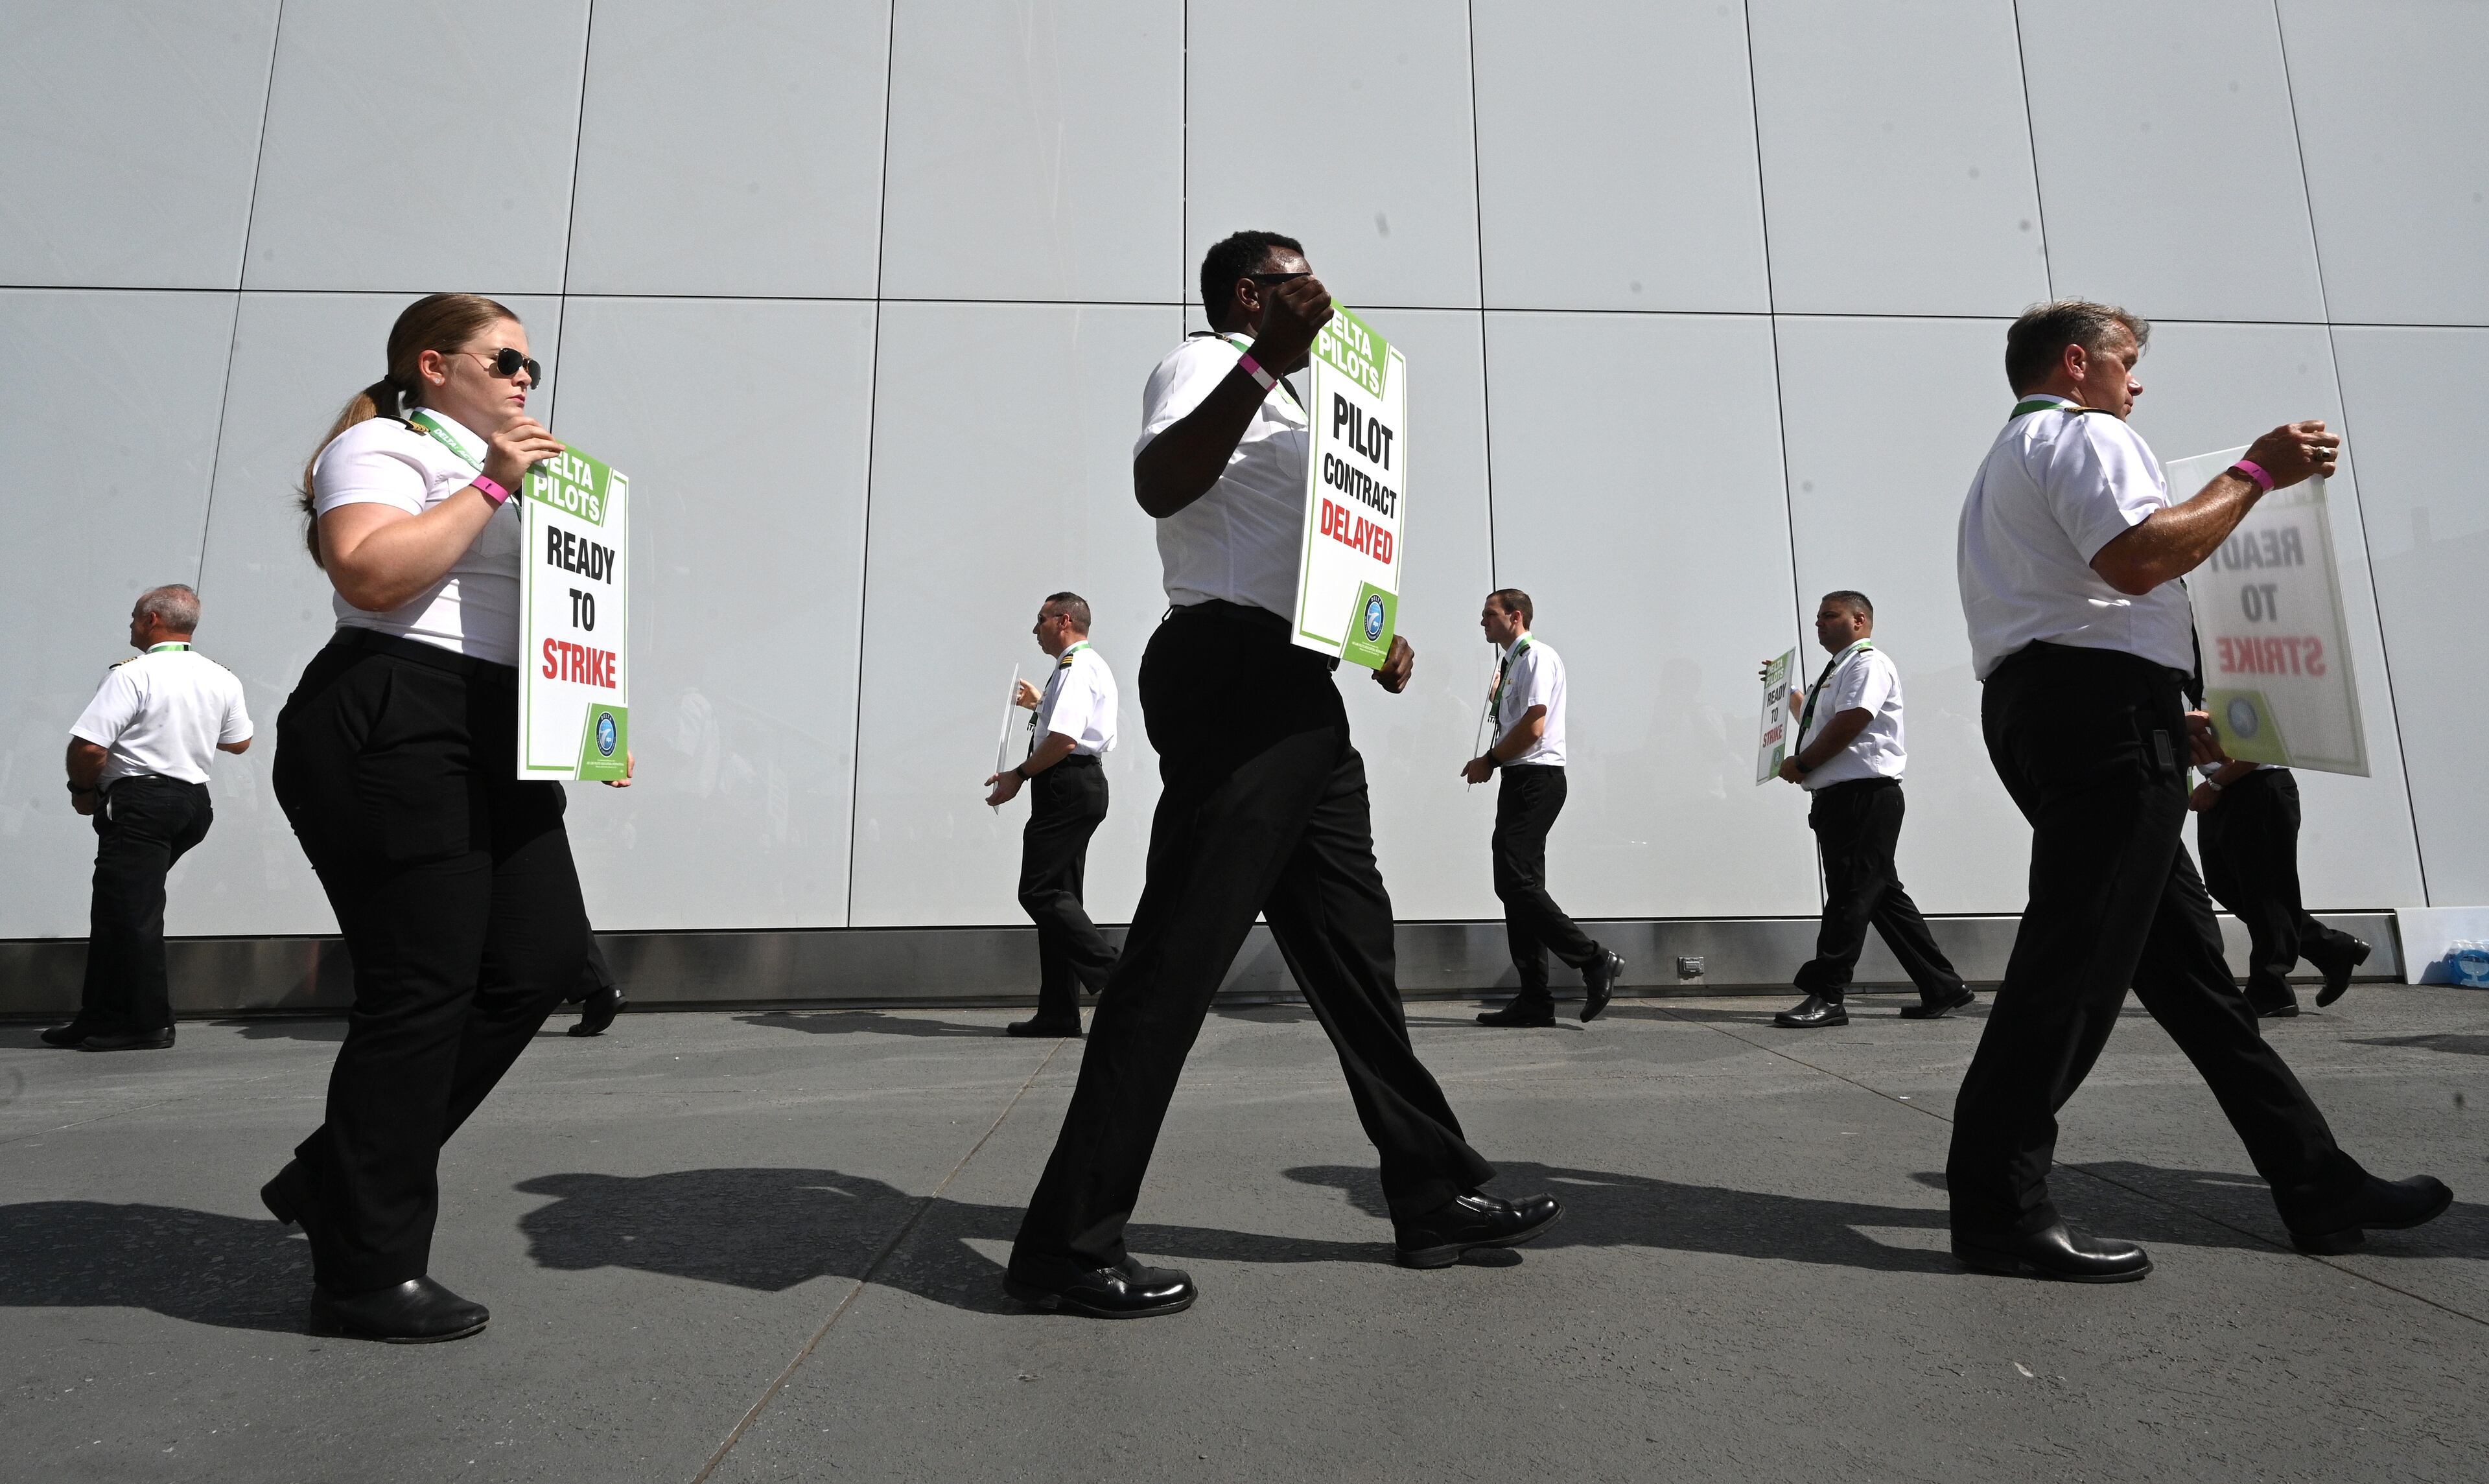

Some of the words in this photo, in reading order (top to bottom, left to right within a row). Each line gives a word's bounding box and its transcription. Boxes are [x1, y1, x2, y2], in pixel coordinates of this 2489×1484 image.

[1323, 308, 1373, 362] ELTA
[1318, 329, 1379, 394] PILOTS
[434, 428, 459, 448] DELTA:
[1333, 391, 1394, 471] PILOT
[533, 469, 600, 522] PILOTS
[1324, 452, 1397, 519] CONTRACT
[547, 525, 615, 585] READY
[1320, 498, 1394, 566] DELAYED
[569, 588, 594, 632] TO
[543, 638, 616, 690] STRIKE
[1766, 667, 1784, 688] PILOTS
[1768, 658, 1783, 675] DELTA
[1767, 682, 1787, 708] READY
[1771, 707, 1779, 724] TO
[1763, 724, 1783, 748] STRIKE
